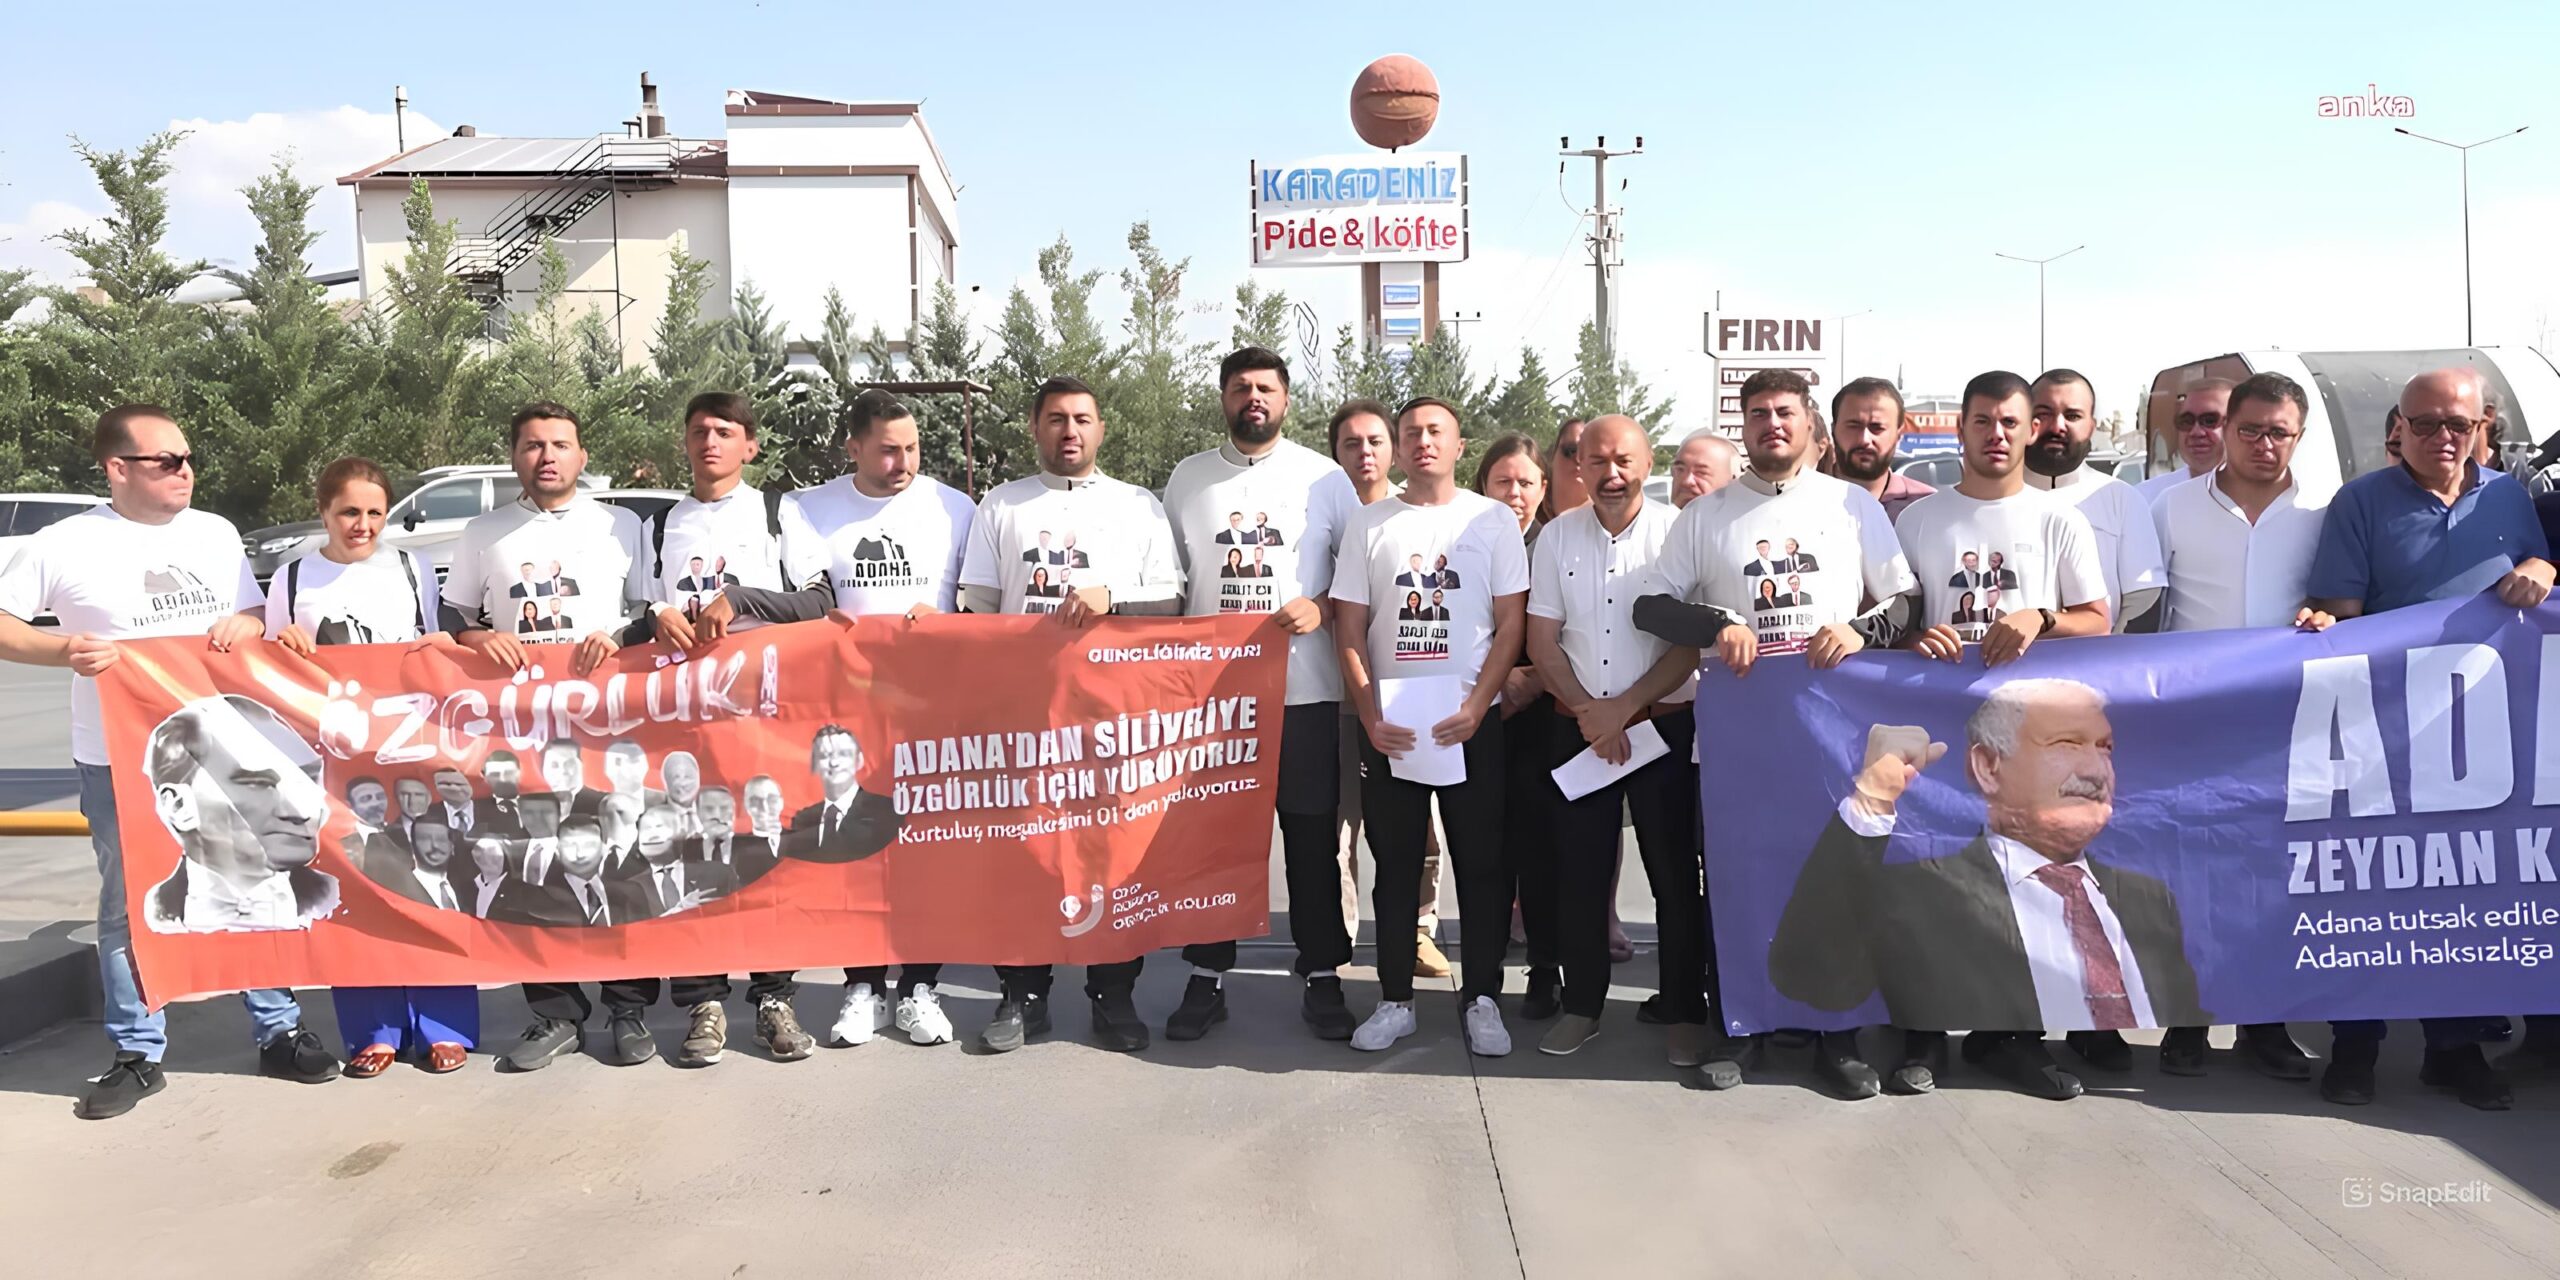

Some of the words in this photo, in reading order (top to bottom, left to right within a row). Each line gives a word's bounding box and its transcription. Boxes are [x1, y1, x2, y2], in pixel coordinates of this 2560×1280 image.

[1262, 161, 1457, 202] KARADENİZ
[1264, 217, 1337, 250] Pide
[1374, 215, 1458, 249] köfte
[1719, 319, 1821, 351] FIRIN
[319, 643, 778, 766] ÖZGÜRLÜK!
[2284, 632, 2560, 823] AD
[894, 725, 1083, 778] ADANA'DAN
[893, 774, 1030, 815] ÖZGÜRLÜK
[898, 820, 983, 844] Kurtuluş
[2287, 829, 2497, 894] ZEYDAN
[2293, 910, 2383, 936] Adana
[2389, 903, 2477, 931] tutsak
[2295, 941, 2401, 970] Adanalı
[2410, 936, 2554, 967] haksızlığa
